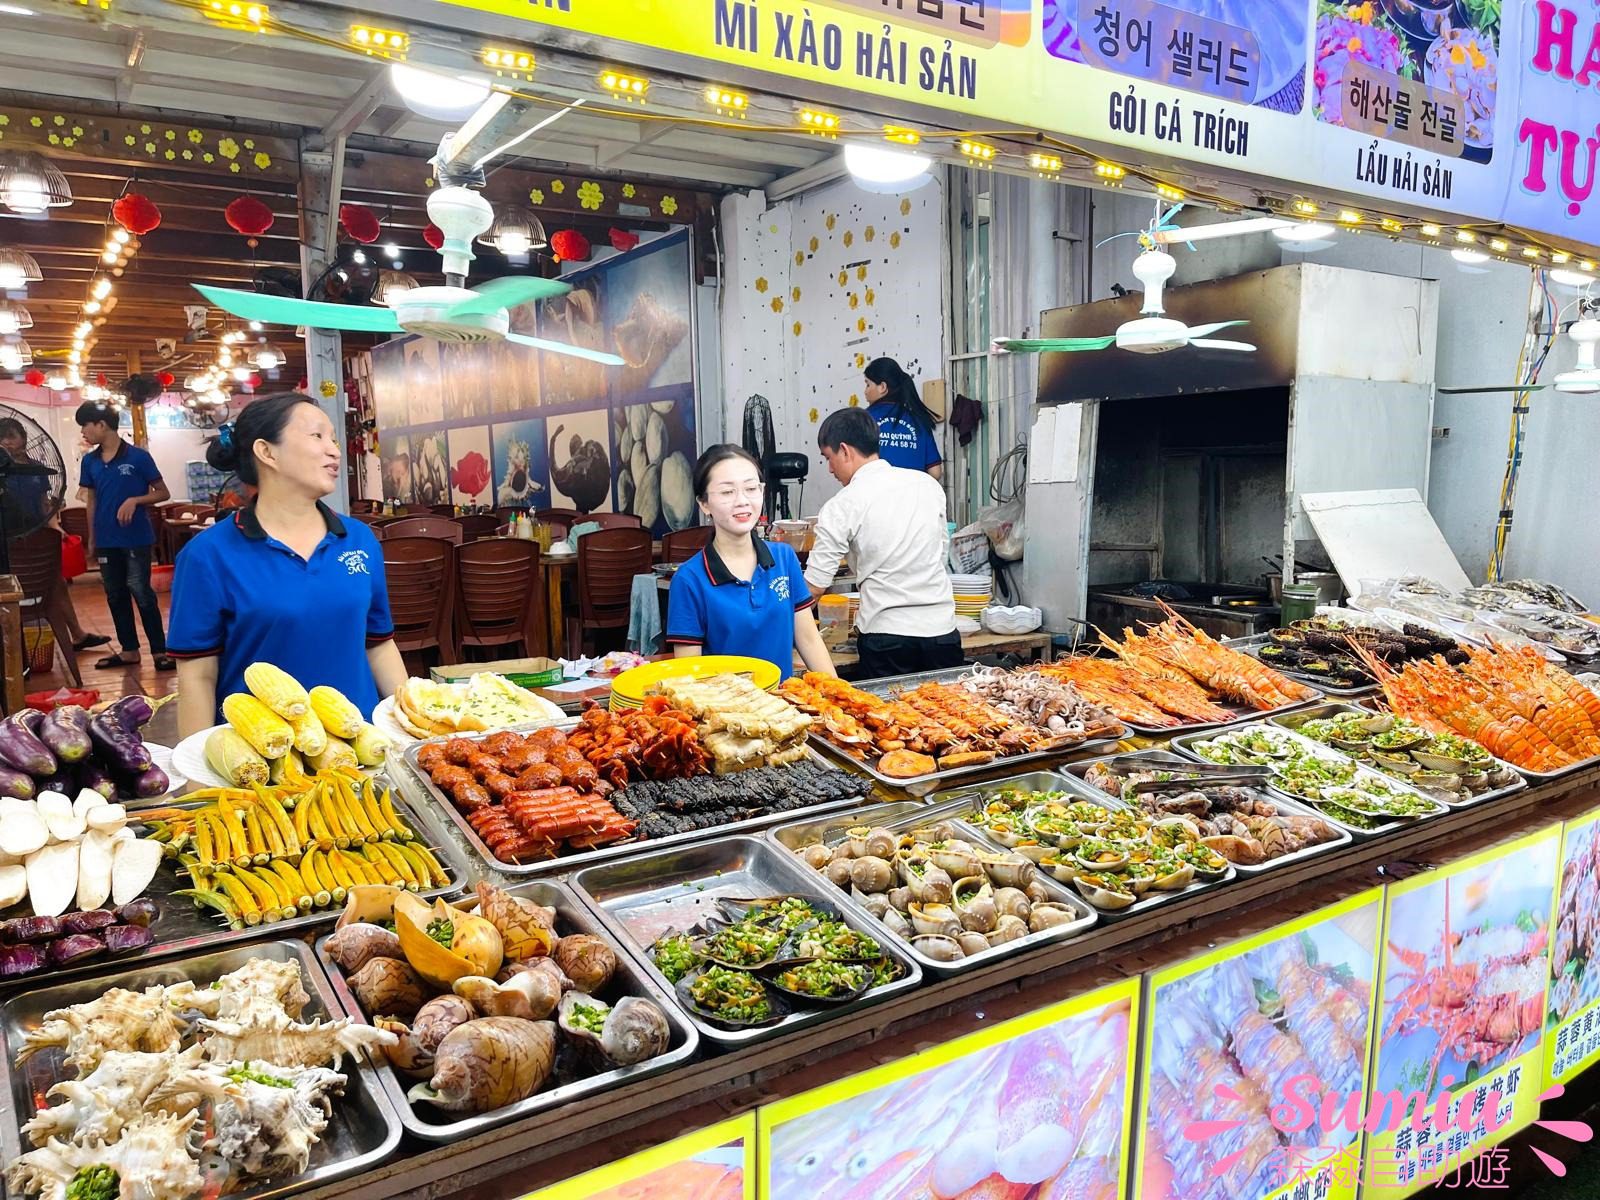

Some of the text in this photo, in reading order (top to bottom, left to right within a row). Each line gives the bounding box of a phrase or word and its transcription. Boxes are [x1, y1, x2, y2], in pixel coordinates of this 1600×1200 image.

[774, 8, 842, 71] XÀO
[856, 24, 907, 85] HẢI
[919, 40, 977, 100] SẢN
[1093, 6, 1250, 87] 청어 샐러드
[1109, 84, 1249, 157] GỎI CÁ TRÍCH
[1350, 77, 1457, 144] 해산물 전골
[1356, 139, 1453, 199] LẨU HẢI SẢN
[878, 439, 889, 447] 77
